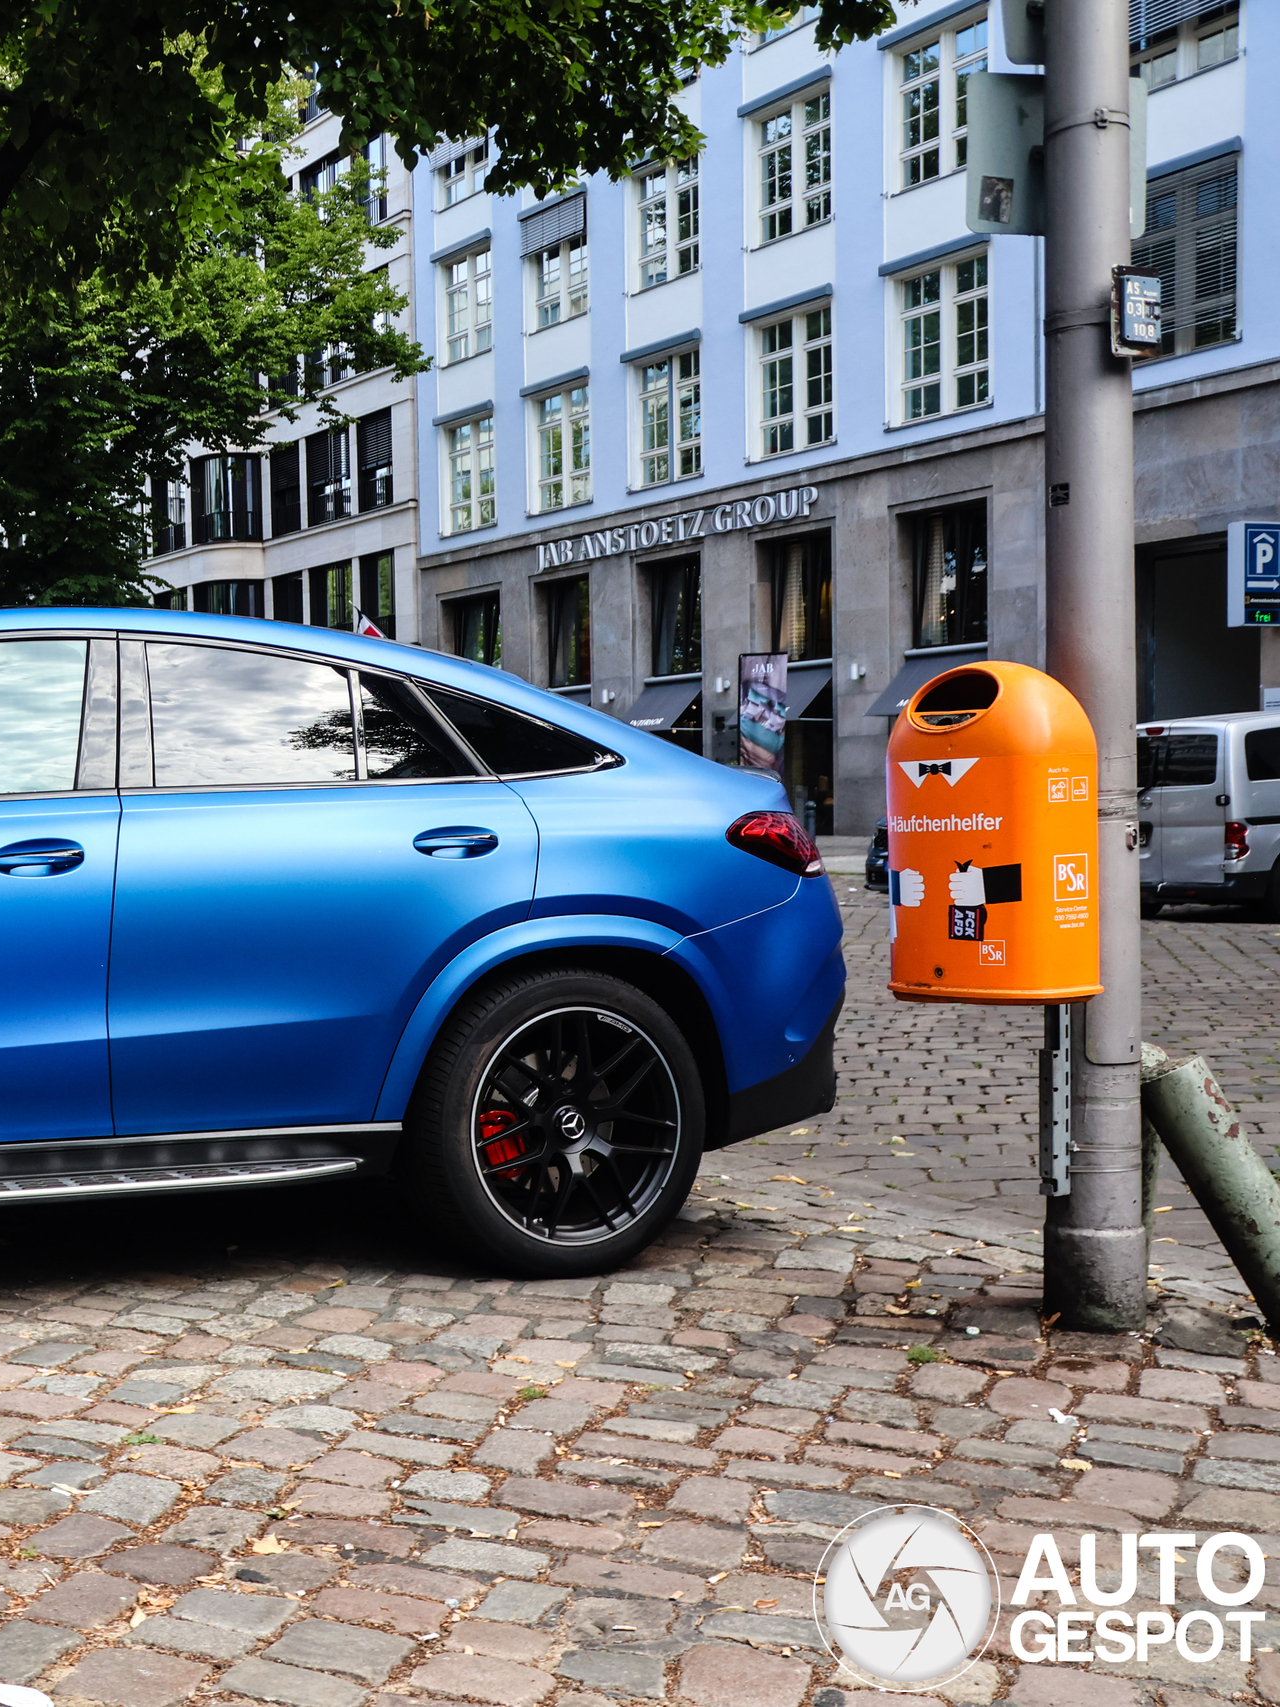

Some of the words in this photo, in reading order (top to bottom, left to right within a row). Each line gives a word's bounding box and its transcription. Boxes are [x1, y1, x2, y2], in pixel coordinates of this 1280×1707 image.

[1126, 281, 1140, 295] AS
[1134, 323, 1155, 339] 10,8
[535, 541, 573, 573] JAB
[580, 510, 705, 559] ANSTOETZ
[712, 486, 818, 531] GROUP
[1256, 543, 1273, 574] P
[1255, 610, 1271, 622] frei
[752, 663, 774, 673] JAB
[889, 813, 1003, 832] Häufchenhelfer
[1058, 863, 1085, 892] BSR
[954, 909, 964, 937] AFD
[965, 910, 975, 938] FCK
[982, 944, 1003, 961] BSR
